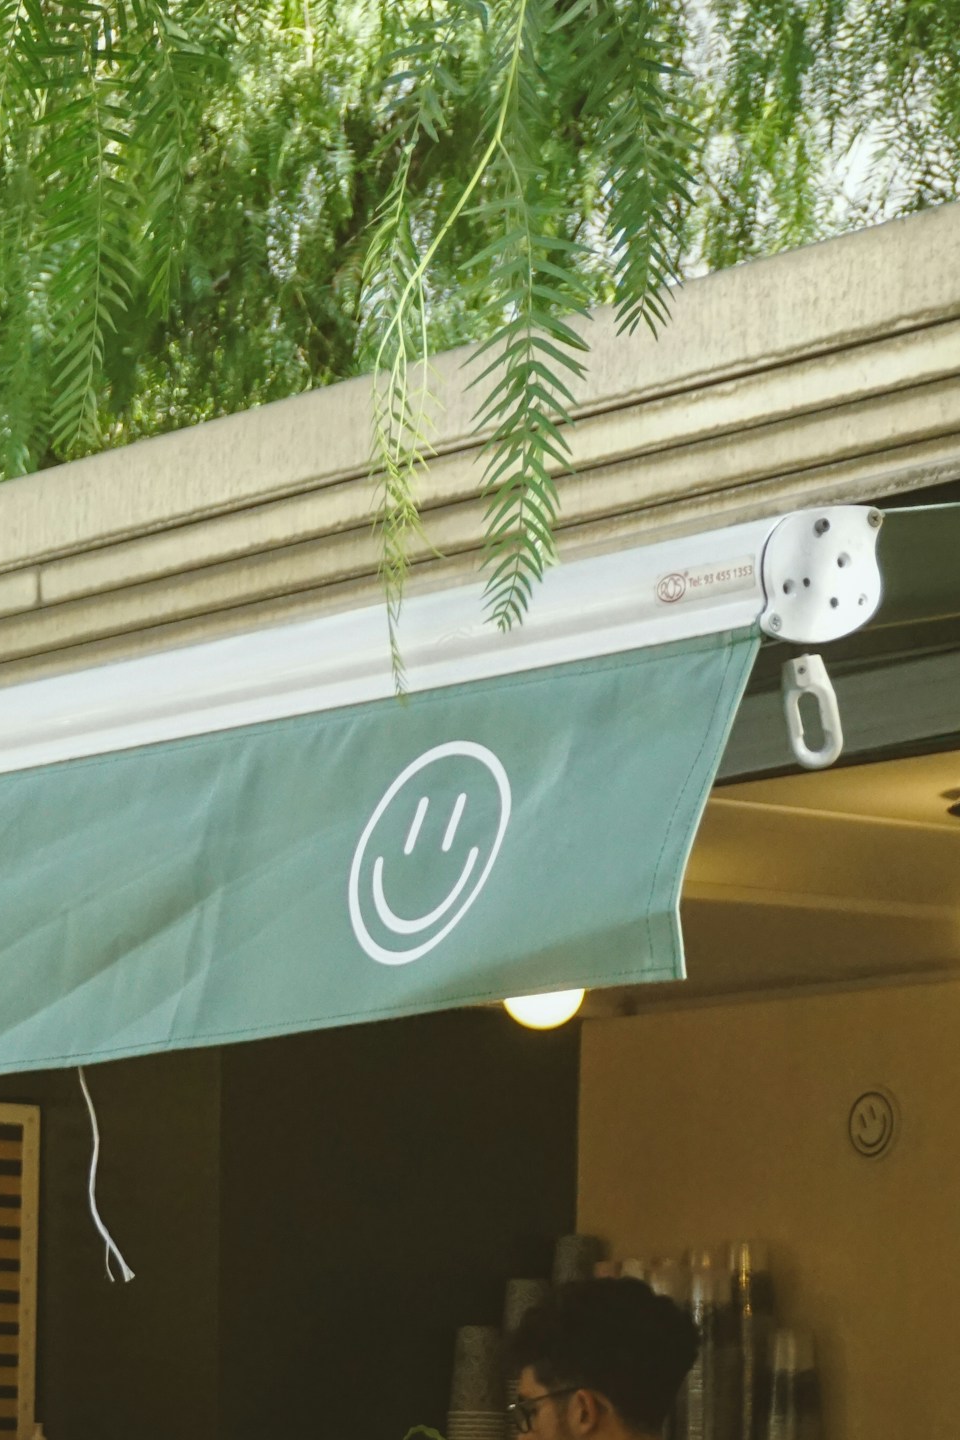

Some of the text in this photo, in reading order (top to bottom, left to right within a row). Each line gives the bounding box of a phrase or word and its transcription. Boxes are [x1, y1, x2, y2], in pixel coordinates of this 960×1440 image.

[688, 564, 753, 588] Tel: 93 455 1353
